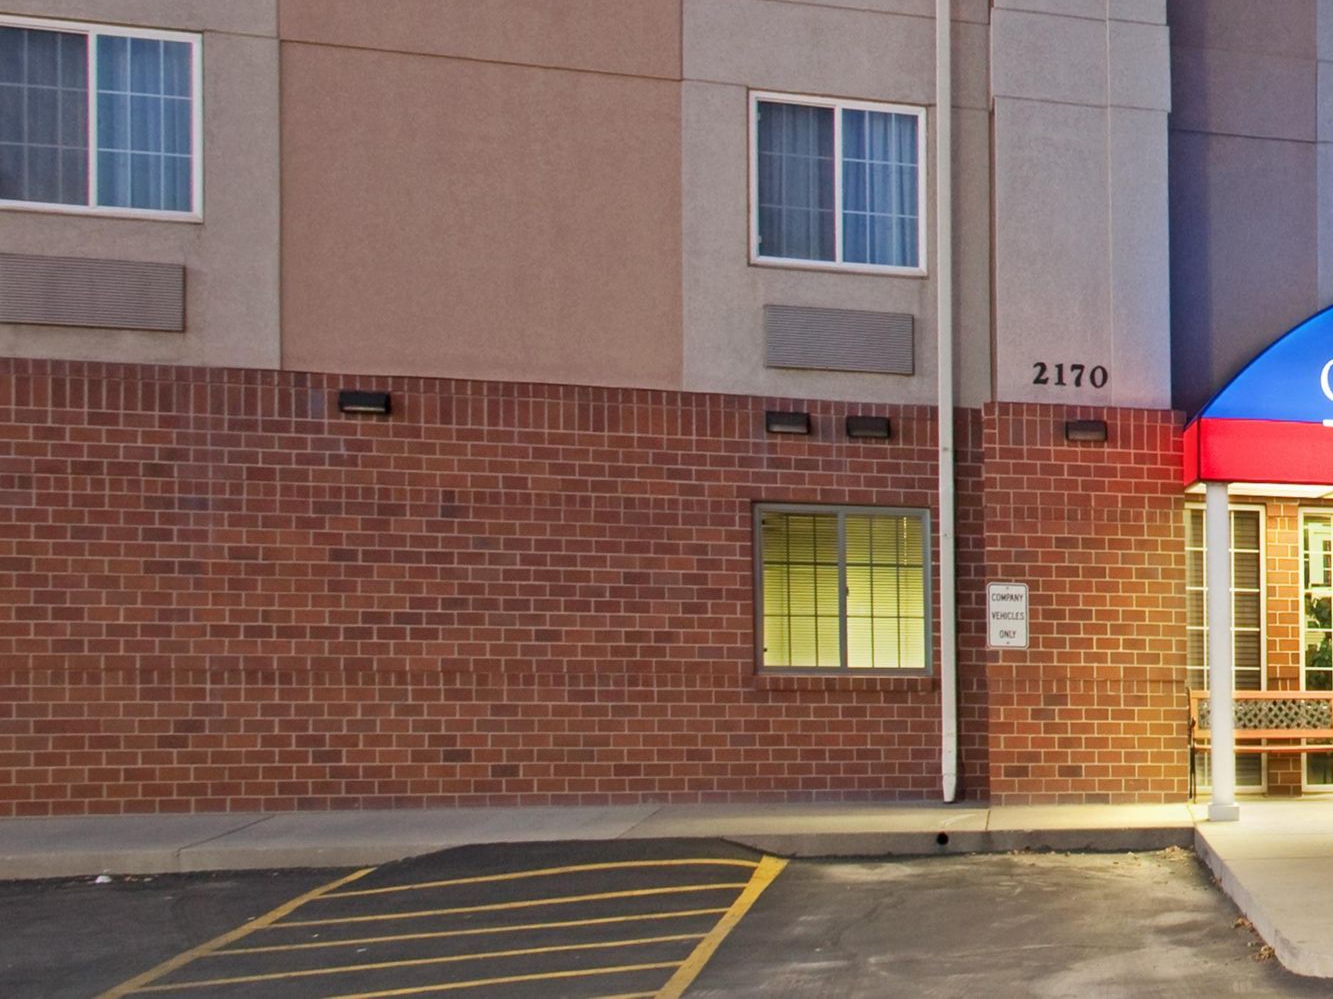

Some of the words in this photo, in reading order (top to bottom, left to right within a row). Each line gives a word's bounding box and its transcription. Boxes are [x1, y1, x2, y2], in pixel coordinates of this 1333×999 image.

[1033, 362, 1108, 388] 2170
[992, 593, 1023, 602] COMPANY
[992, 611, 1025, 620] VEHICLES
[999, 630, 1016, 639] ONLY
